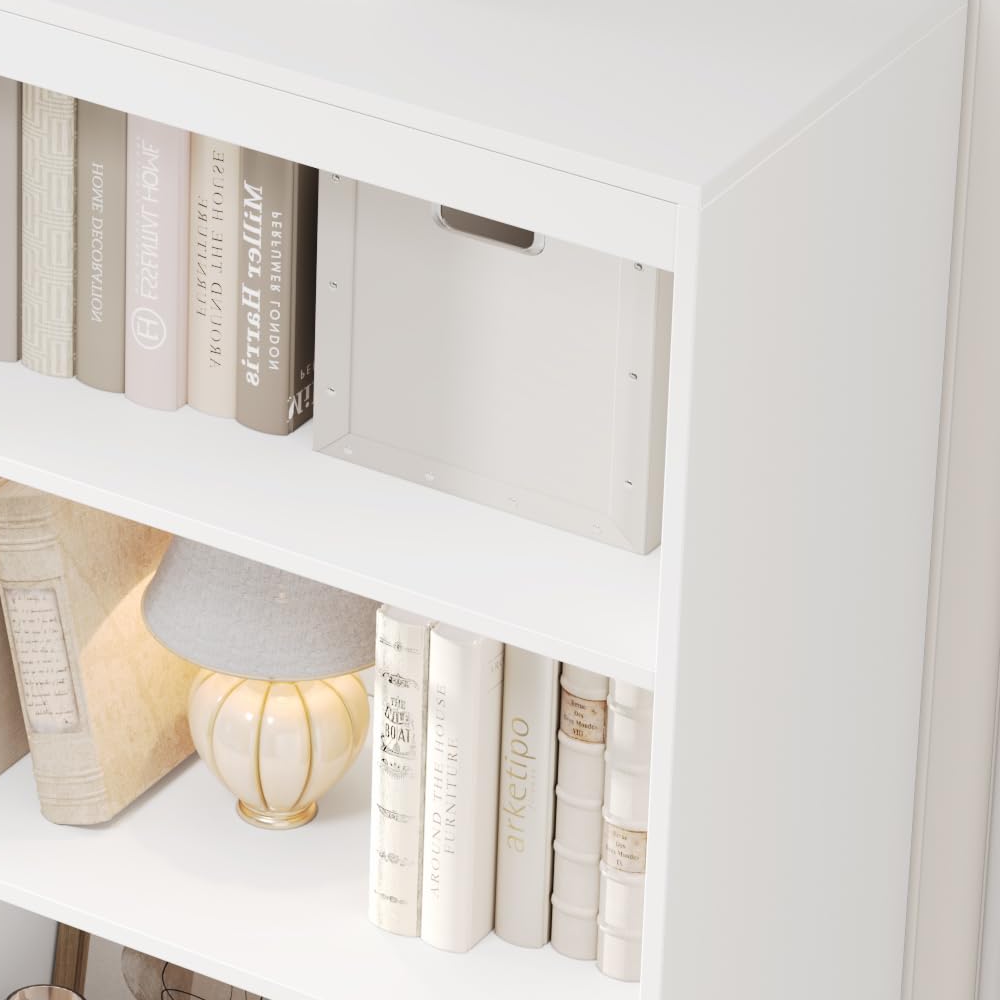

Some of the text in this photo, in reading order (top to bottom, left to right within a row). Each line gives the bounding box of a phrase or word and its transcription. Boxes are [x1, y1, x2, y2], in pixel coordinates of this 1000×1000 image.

[430, 685, 447, 898] AROUND THE HOUSE
[445, 738, 459, 854] FURNITURE
[504, 717, 537, 854] arketipo
